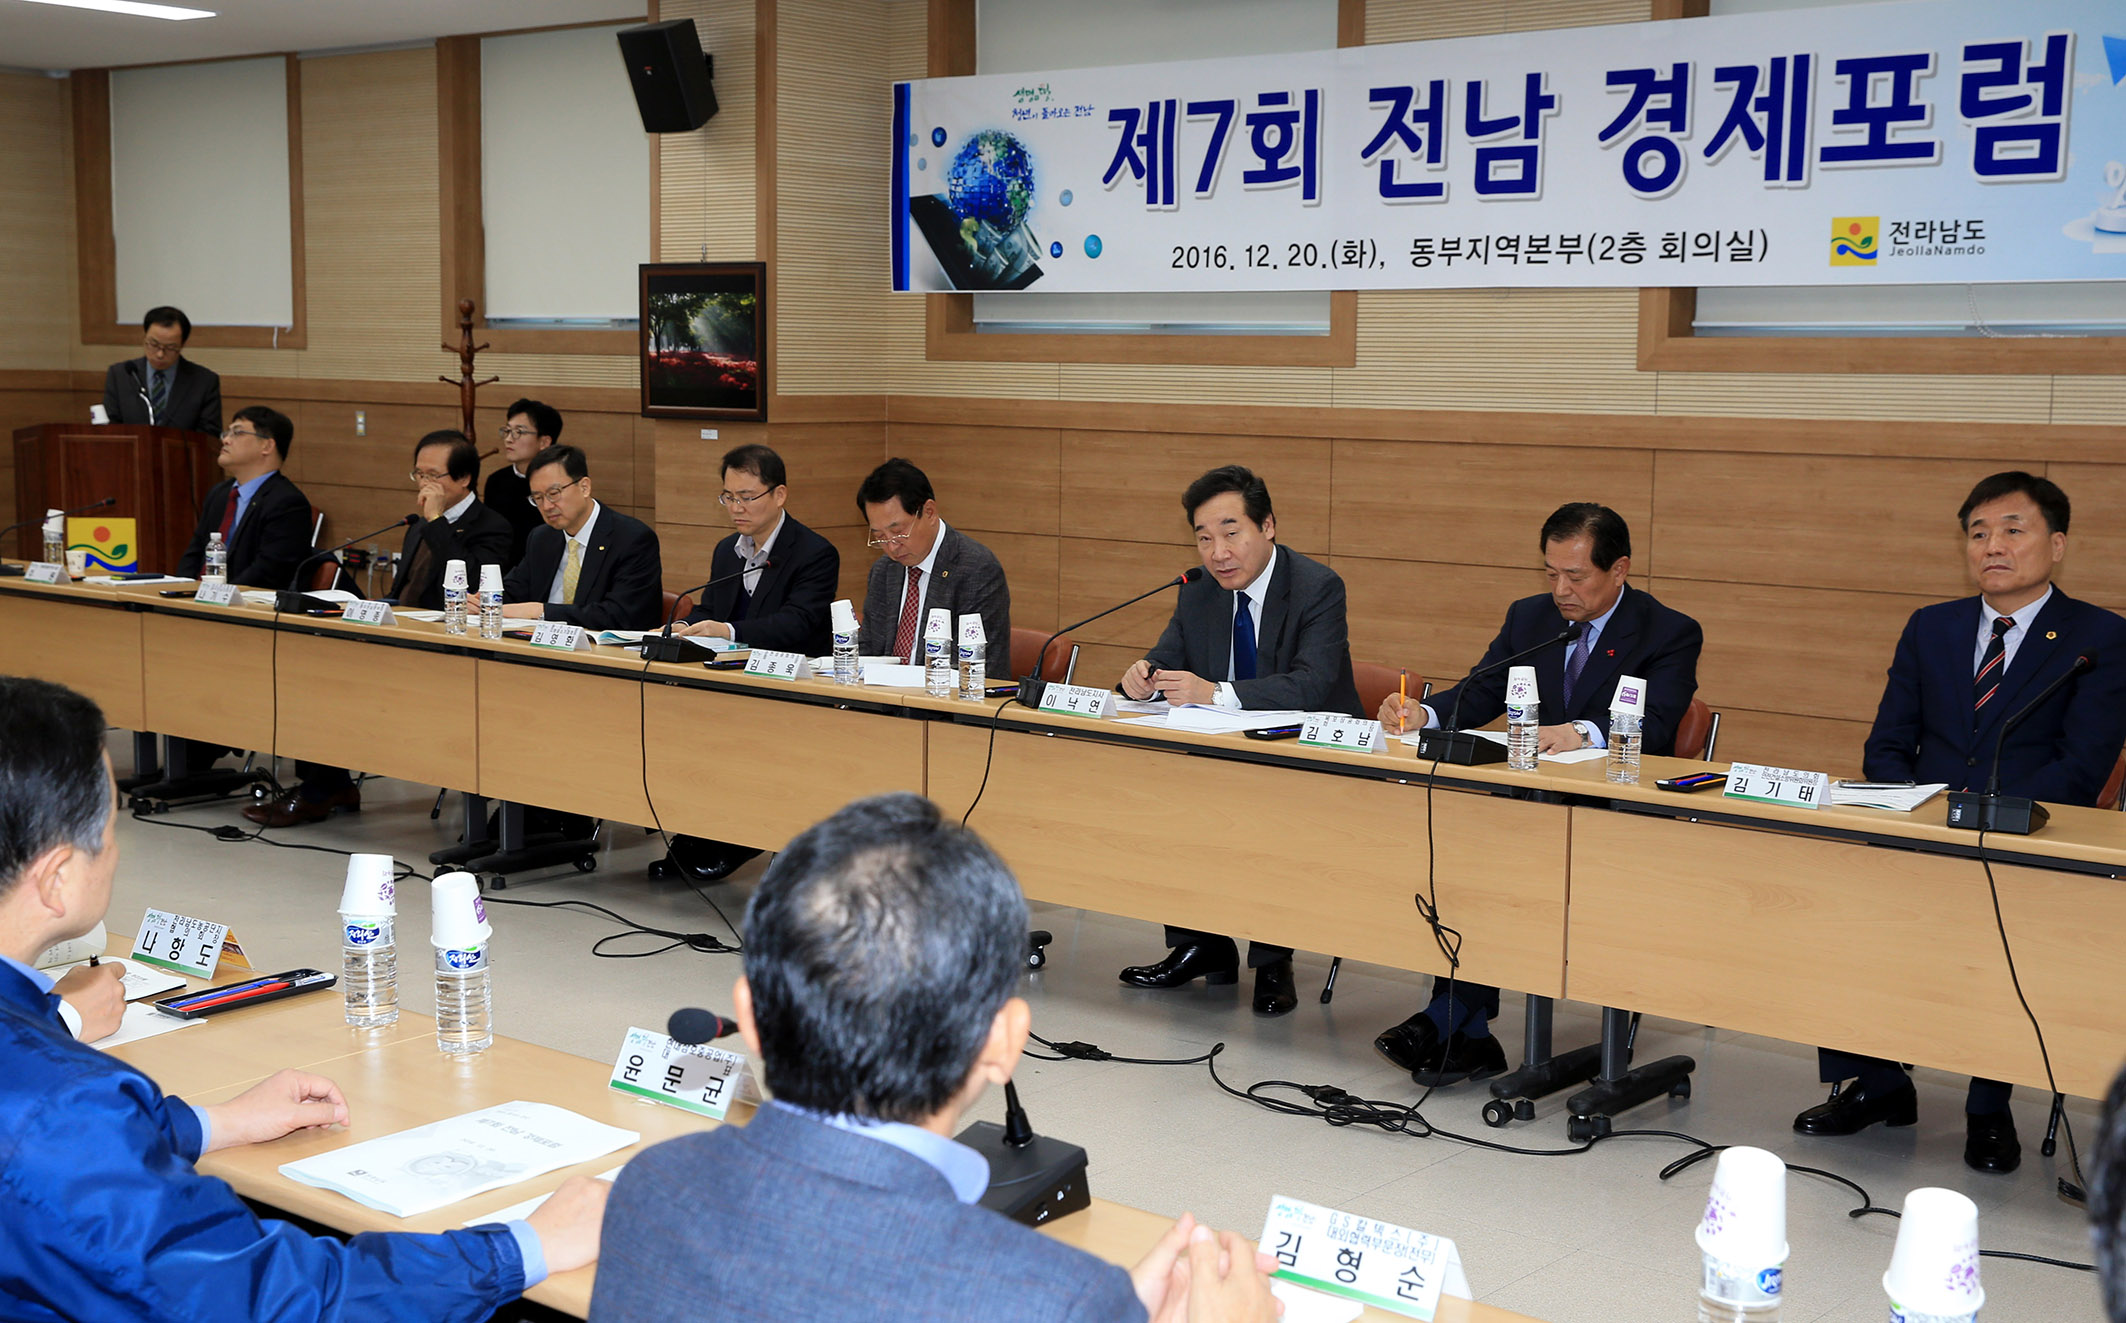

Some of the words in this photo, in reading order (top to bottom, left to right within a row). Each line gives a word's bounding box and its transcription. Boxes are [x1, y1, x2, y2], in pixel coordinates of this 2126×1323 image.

[1102, 88, 1320, 206] 제7회
[1361, 72, 1555, 200] 전남
[1598, 33, 2070, 193] 경제포럼
[1889, 219, 1986, 245] 전라남도
[1171, 245, 1235, 271] 2016.
[1245, 244, 1278, 270] 12.
[1410, 232, 1647, 268] 동부지역본부(2층
[1659, 228, 1769, 263] 회의실)
[1889, 245, 1986, 257] JeollaNamdo
[1045, 693, 1101, 714] 이낙연
[1068, 686, 1106, 699] 전라남도지사
[1306, 726, 1371, 747] 김호남
[1733, 777, 1815, 802] 김기태
[141, 930, 214, 967] 나항도
[623, 1054, 725, 1105] 윤문균
[1276, 1231, 1425, 1301] 김형순
